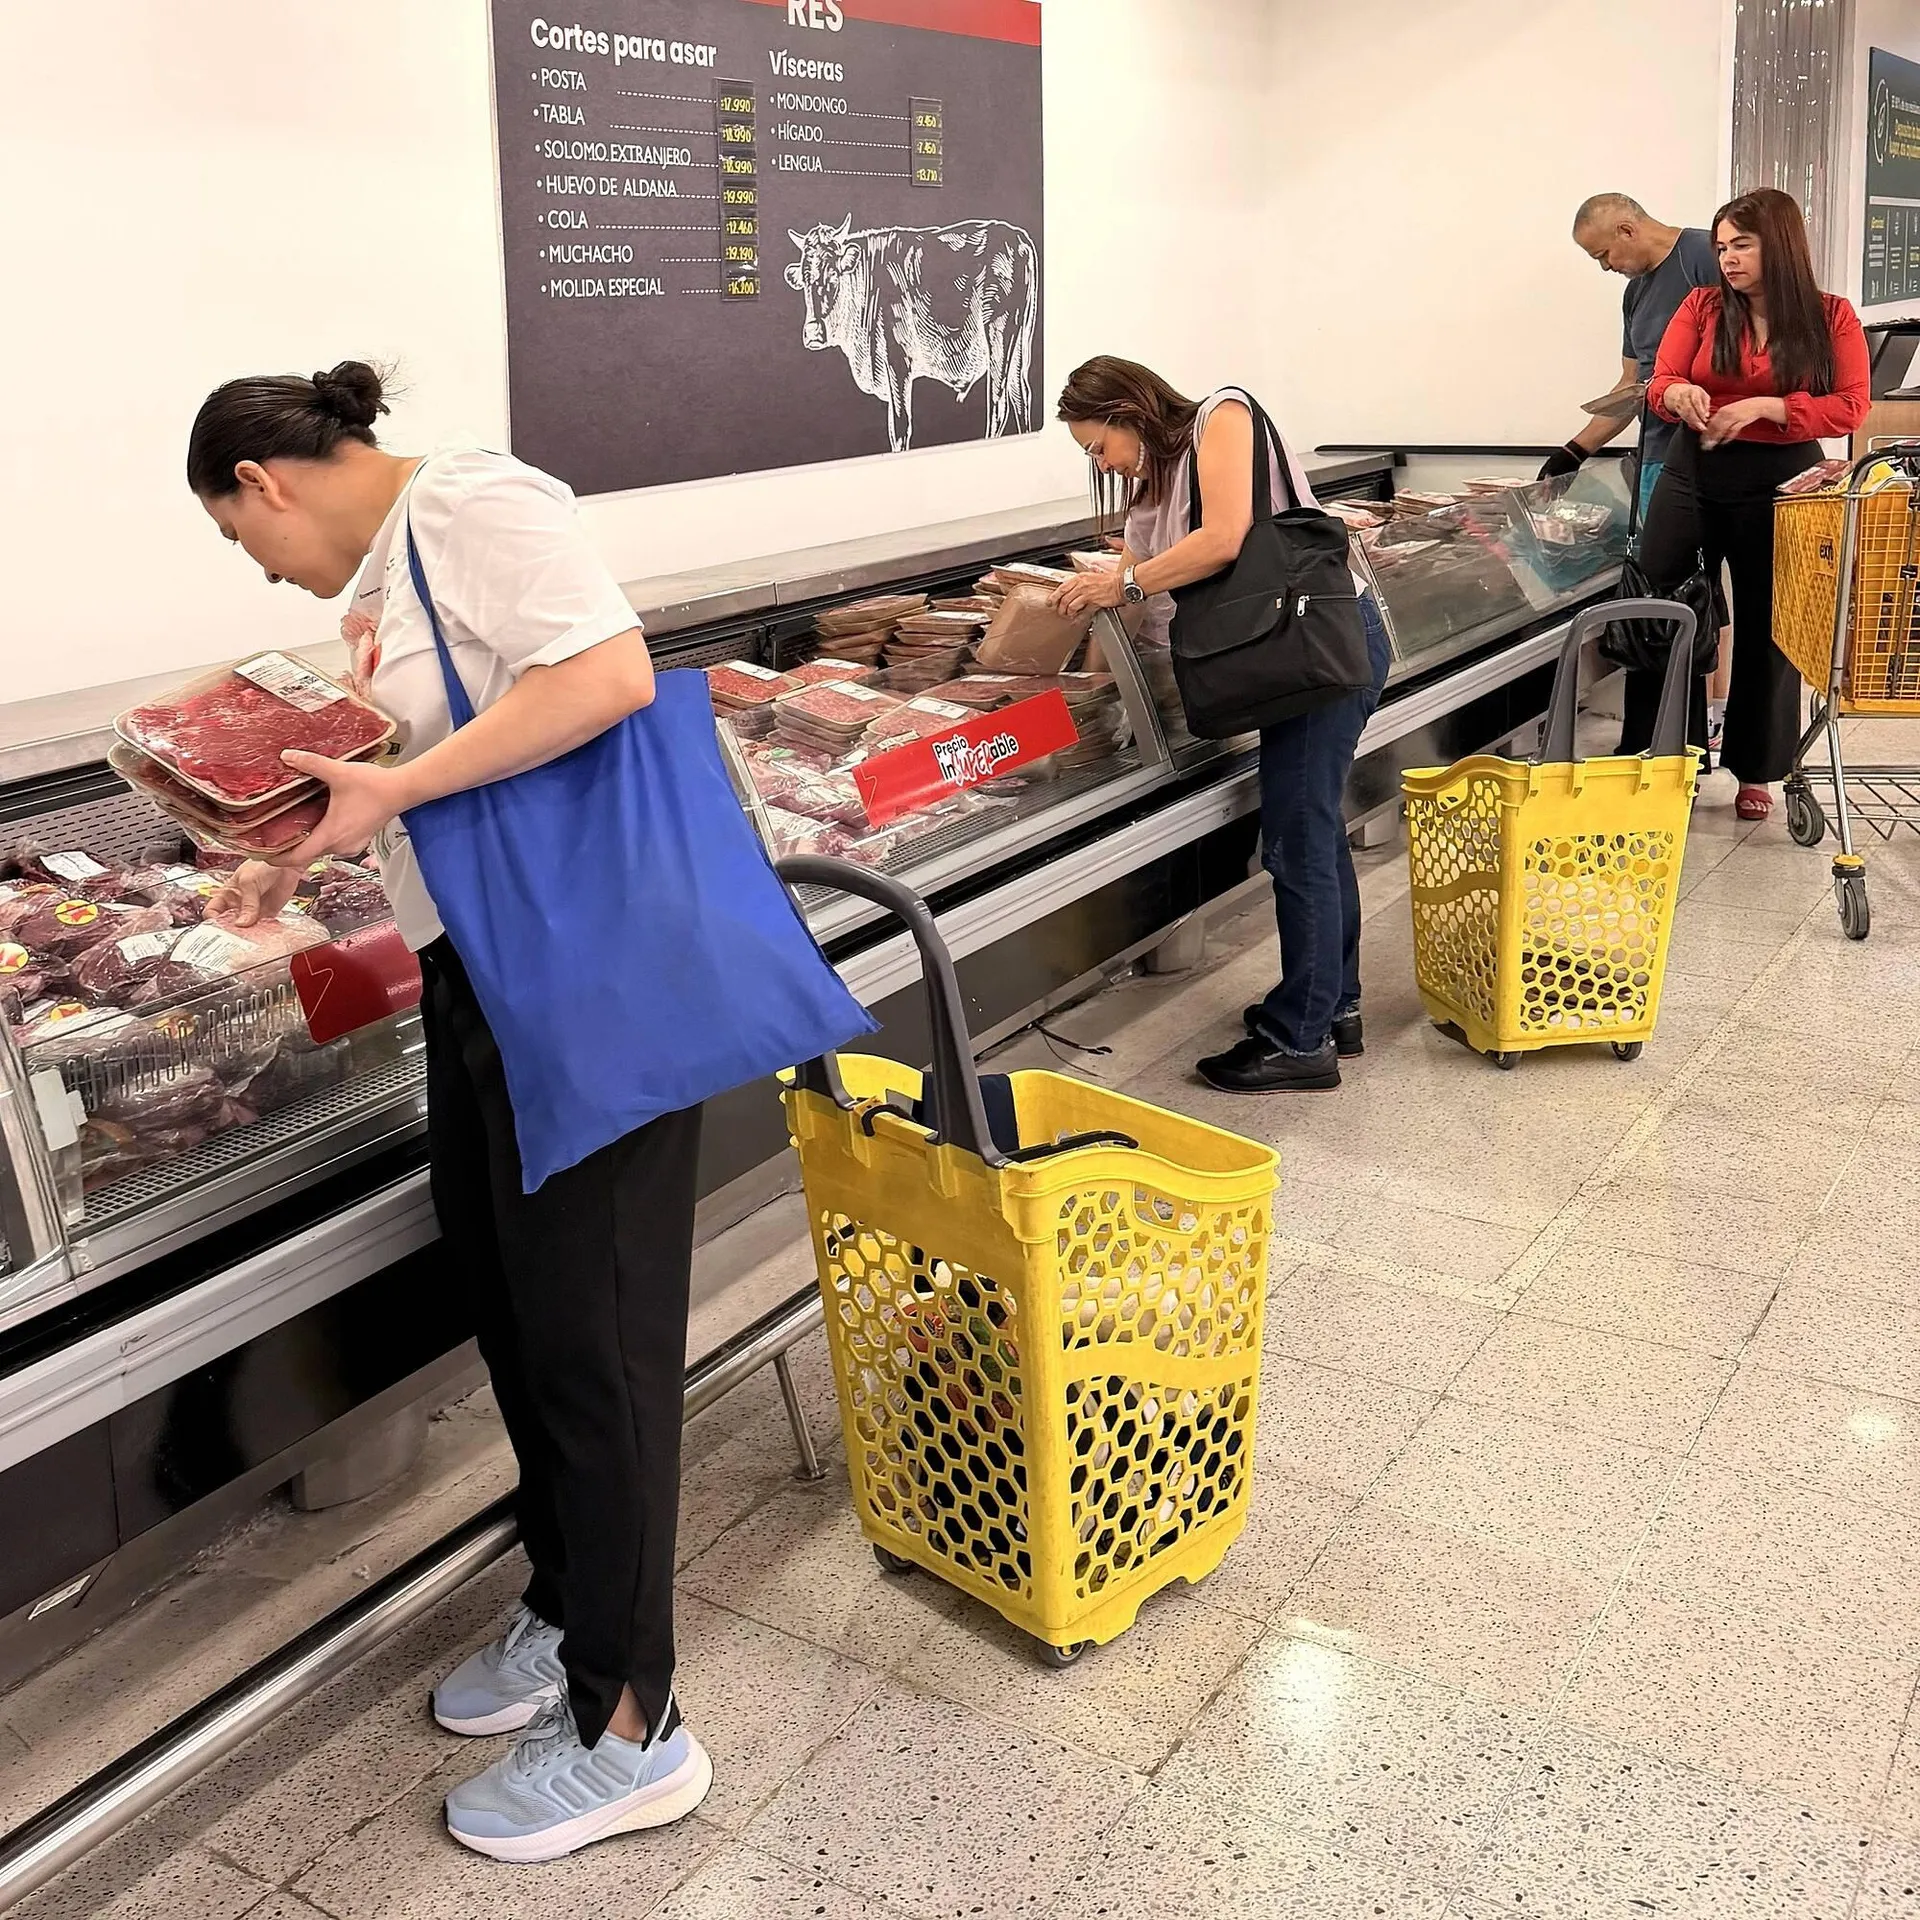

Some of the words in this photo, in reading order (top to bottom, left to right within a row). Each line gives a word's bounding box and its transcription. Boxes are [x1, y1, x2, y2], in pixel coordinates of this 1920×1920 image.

[787, 0, 844, 32] RES
[530, 18, 610, 55] Cortes
[613, 34, 666, 66] para
[669, 41, 717, 68] asar
[768, 48, 844, 82] Vísceras
[541, 67, 588, 91] POSTA
[540, 103, 586, 126] TABLA
[777, 92, 848, 115] MONDONGO
[777, 119, 824, 143] HÍGADO
[543, 139, 607, 162] SOLOMO
[610, 143, 692, 170] EXTRANJERO
[778, 153, 823, 173] LENGUA
[546, 174, 596, 195] HUEVO
[599, 177, 619, 196] DE
[622, 178, 678, 198] ALDANA
[547, 209, 589, 229] COLA
[549, 244, 634, 264] MUCHACHO
[550, 278, 606, 298] MOLIDA
[608, 277, 665, 297] ESPECIAL
[934, 736, 967, 758] Precio
